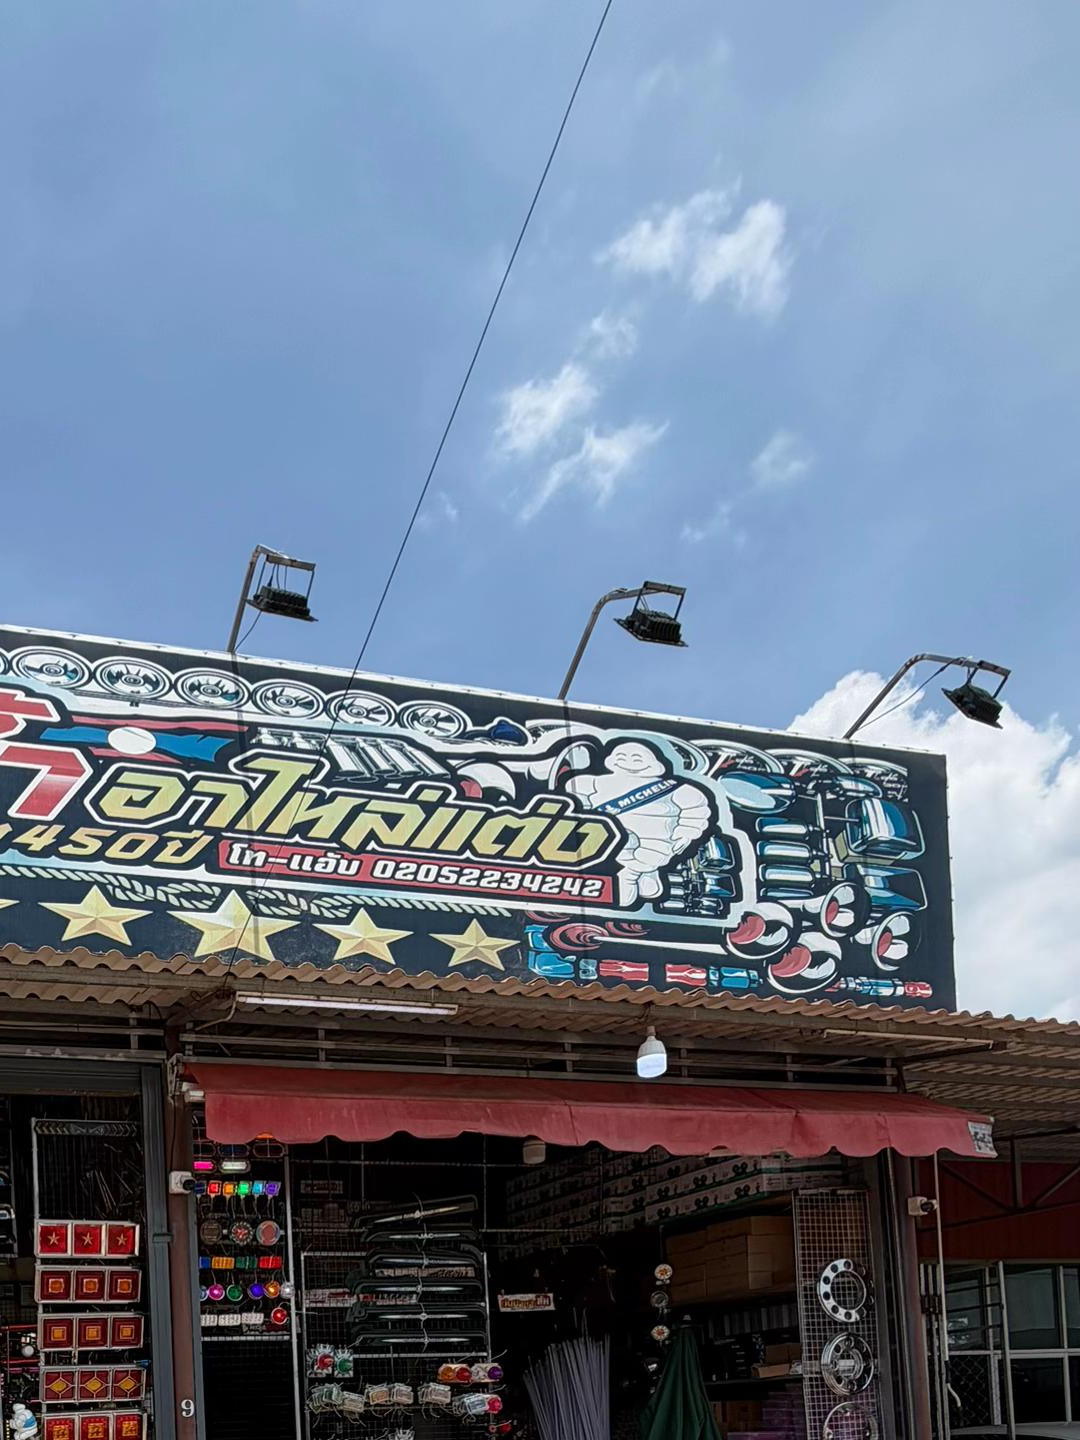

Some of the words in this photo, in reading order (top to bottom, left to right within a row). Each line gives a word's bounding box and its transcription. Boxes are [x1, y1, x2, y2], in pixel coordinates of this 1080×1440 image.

[617, 778, 678, 809] MICHELIN
[371, 859, 604, 898] 02052234242
[180, 1398, 195, 1418] 9
